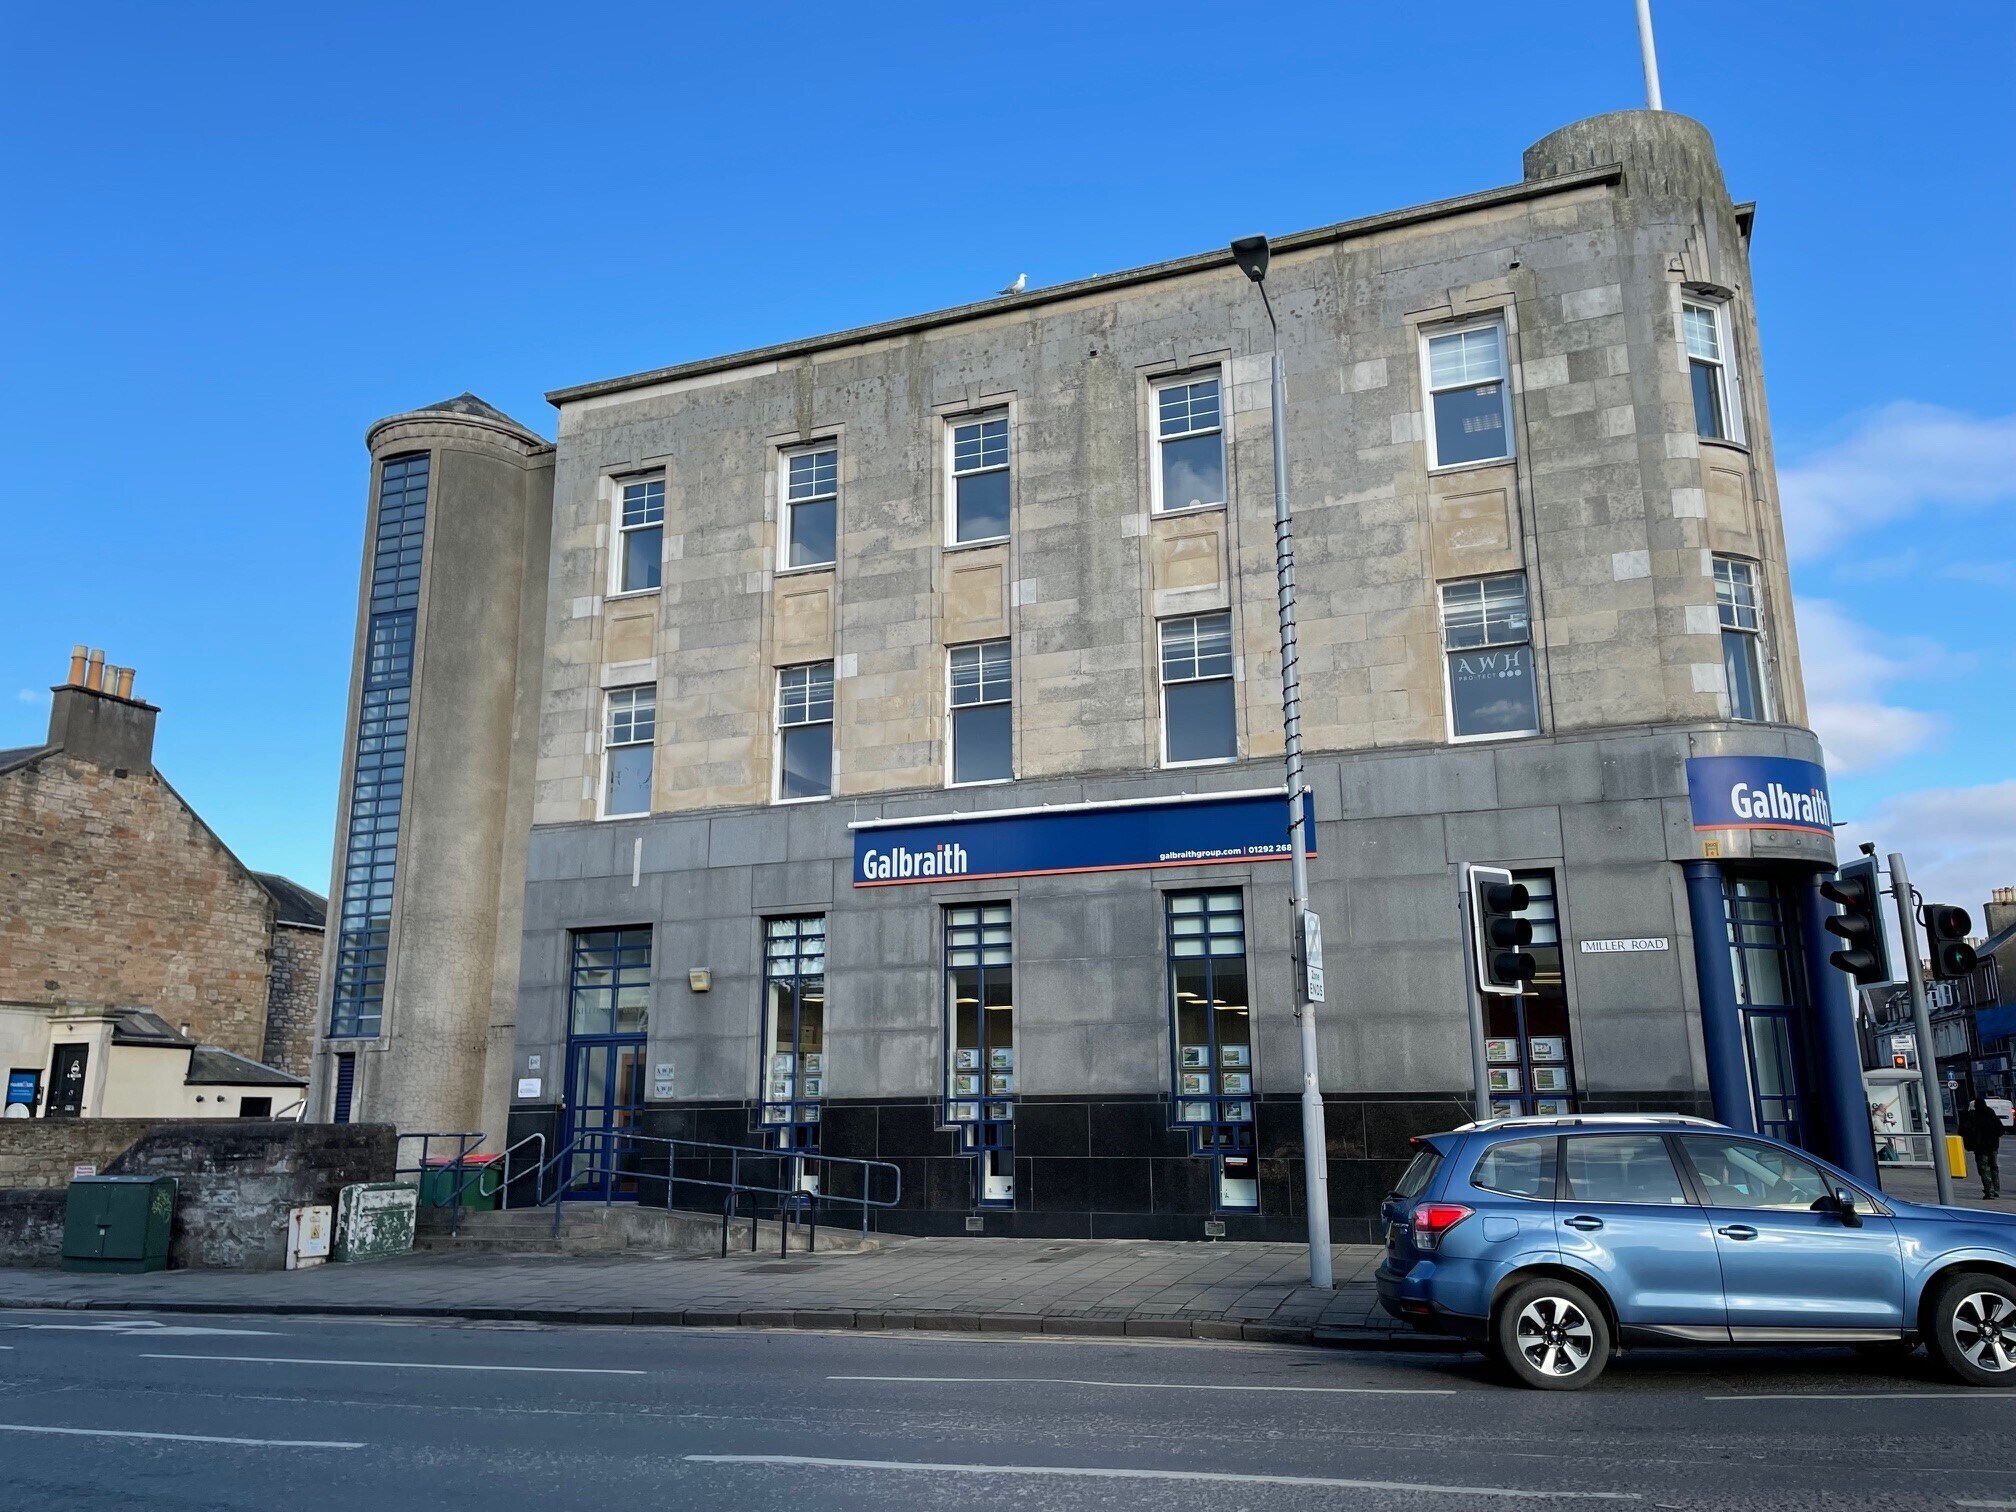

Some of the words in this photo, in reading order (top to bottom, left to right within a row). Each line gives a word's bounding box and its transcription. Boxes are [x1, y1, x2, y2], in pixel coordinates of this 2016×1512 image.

[1731, 782, 1830, 827] Galbraith
[863, 843, 967, 879] Galbraith
[1159, 847, 1242, 861] galbraithgroup.com
[1248, 845, 1274, 854] 01292
[1585, 941, 1626, 951] MILLER
[1631, 939, 1664, 950] ROAD
[1309, 982, 1323, 997] ENDS
